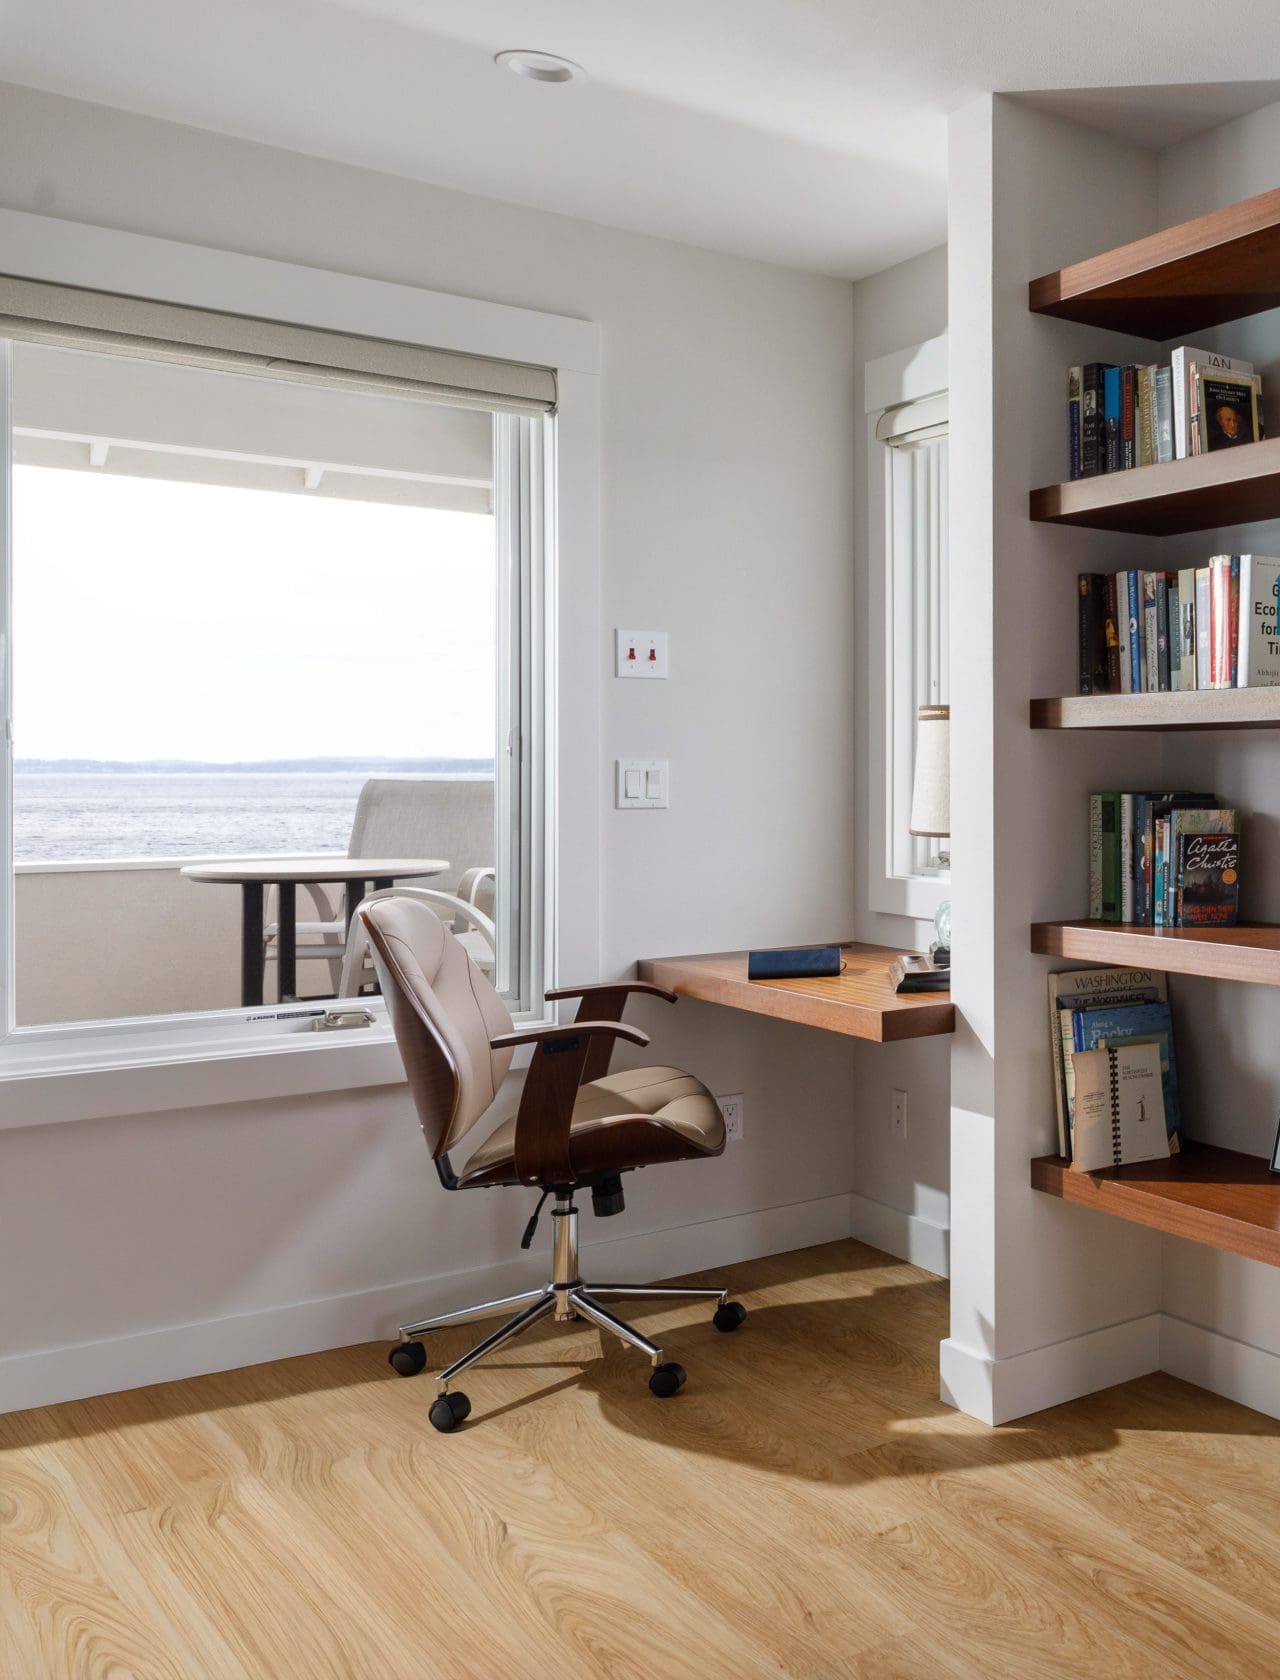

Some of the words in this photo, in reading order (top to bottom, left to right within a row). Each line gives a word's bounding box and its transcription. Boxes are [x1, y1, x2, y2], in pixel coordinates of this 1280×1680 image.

[1209, 355, 1231, 369] IAN
[1261, 622, 1279, 635] for
[1187, 838, 1237, 857] Agatha
[1186, 853, 1237, 870] Christie
[1075, 971, 1152, 990] WASHINGTON
[1092, 1026, 1134, 1041] Rocky
